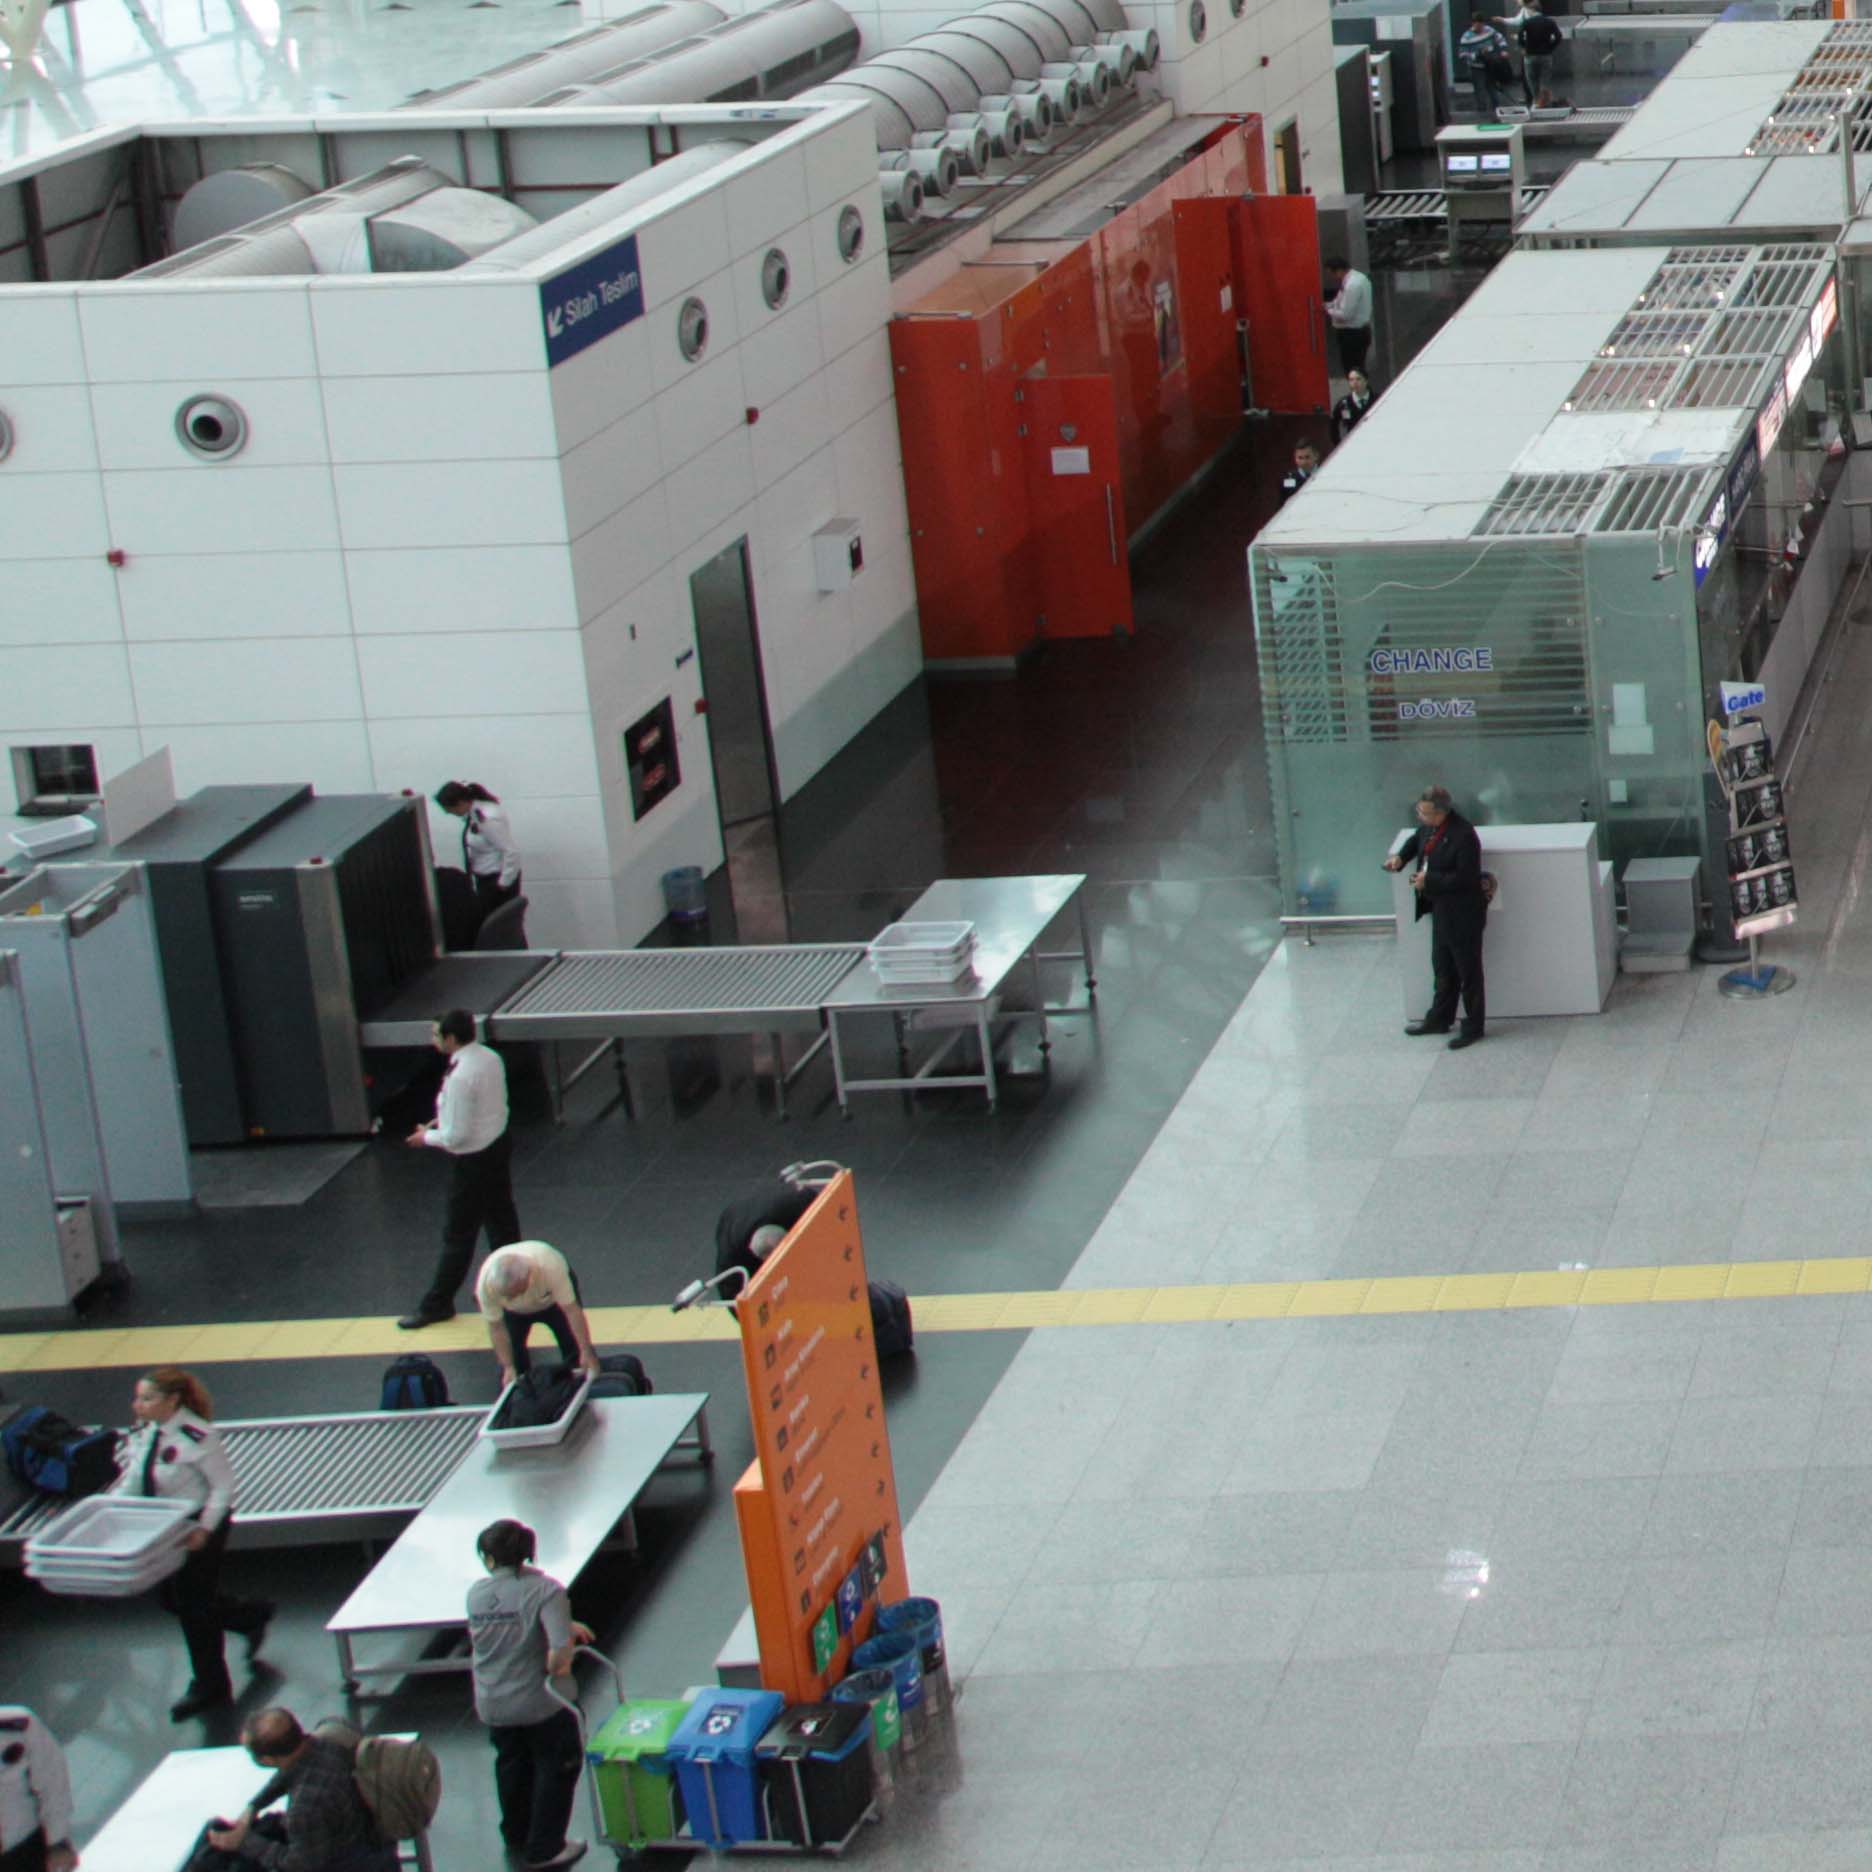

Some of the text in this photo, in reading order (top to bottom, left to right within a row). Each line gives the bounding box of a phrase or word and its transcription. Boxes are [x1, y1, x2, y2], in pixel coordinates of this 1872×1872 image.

[565, 271, 639, 326] Silah Teslim
[1371, 647, 1493, 673] CHANGE
[1399, 698, 1476, 719] DÖVİZ
[1728, 690, 1764, 712] Gate
